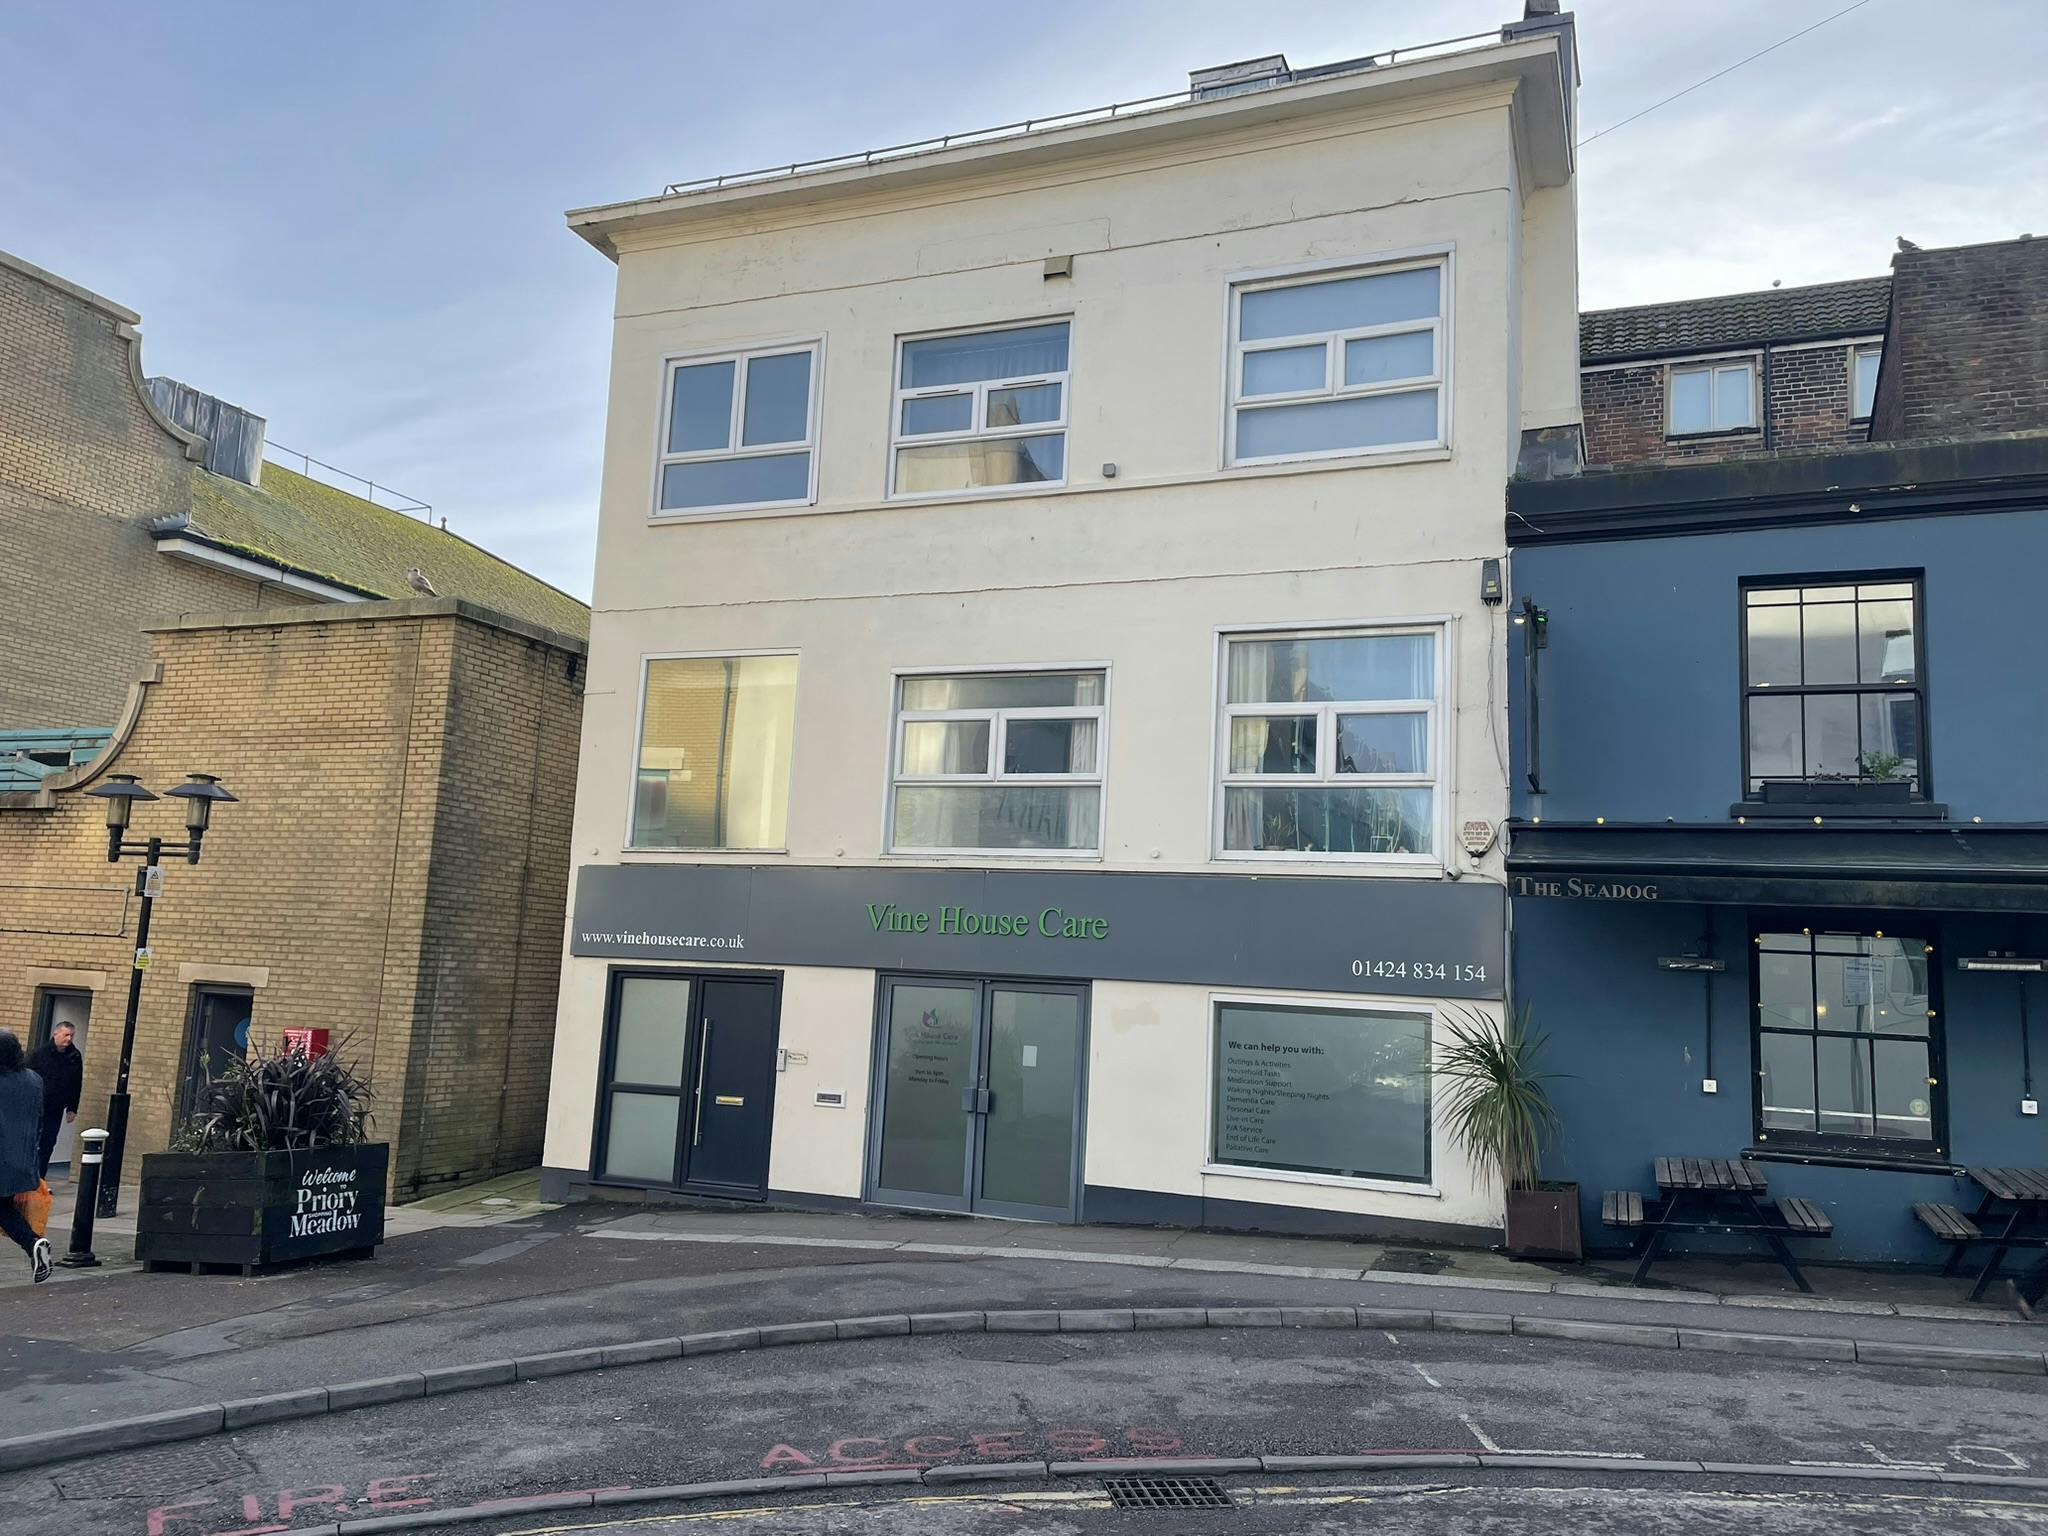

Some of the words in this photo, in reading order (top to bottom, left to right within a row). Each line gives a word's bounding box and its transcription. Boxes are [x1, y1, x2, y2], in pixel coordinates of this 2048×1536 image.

[1515, 876, 1562, 897] THE
[1567, 877, 1657, 900] SEADOG
[866, 903, 929, 933] Vine
[937, 905, 1029, 936] House
[1038, 907, 1109, 939] Care
[581, 930, 744, 949] www.vinehousecare.co.uk
[1351, 959, 1406, 978] 01424
[1413, 962, 1446, 980] 834
[1454, 964, 1486, 982] 154
[1228, 1041, 1241, 1049] We
[1244, 1043, 1258, 1051] can
[1261, 1042, 1280, 1054] help
[1282, 1046, 1299, 1054] you
[1301, 1046, 1324, 1055] with:
[1228, 1058, 1253, 1066] Outings
[1261, 1060, 1291, 1068] Activities
[1227, 1068, 1262, 1076] Household
[1227, 1076, 1263, 1085] Medication
[1265, 1080, 1292, 1088] Support
[1227, 1087, 1251, 1095] Waking
[1227, 1096, 1258, 1104] Dementia
[1227, 1105, 1254, 1113] Personal
[1240, 1126, 1262, 1134] Service
[302, 1167, 357, 1186] Welcome
[296, 1187, 359, 1215] Priory
[288, 1210, 362, 1238] Meadow
[147, 1473, 436, 1536] FIRE
[760, 1427, 1182, 1468] ACCESS
